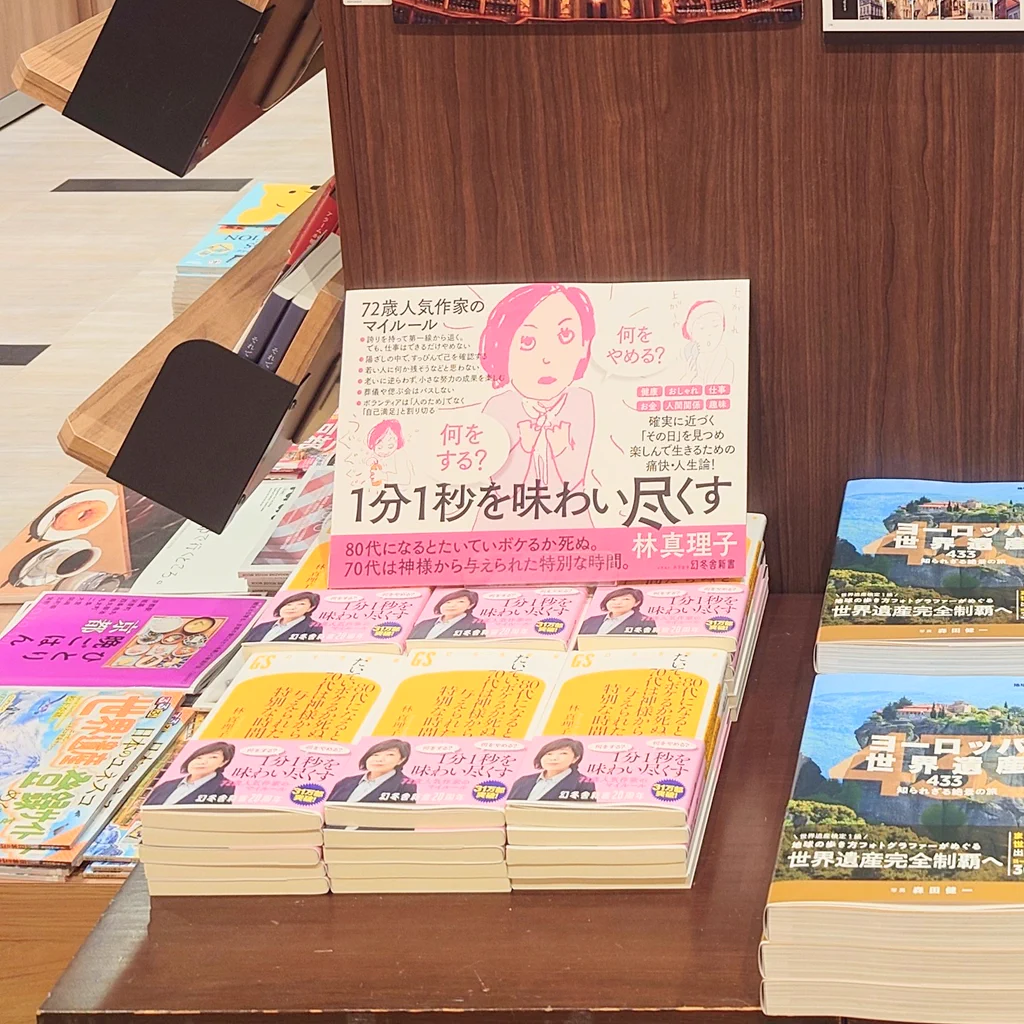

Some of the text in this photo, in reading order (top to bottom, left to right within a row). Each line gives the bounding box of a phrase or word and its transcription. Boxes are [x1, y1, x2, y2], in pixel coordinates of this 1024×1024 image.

[361, 298, 485, 317] 72歳人気作家の
[364, 319, 438, 333] マイルール
[617, 326, 652, 344] 何を
[641, 386, 726, 396] 健康 おしゃれ 仕事
[641, 402, 658, 411] お金
[666, 401, 699, 410] 人間関係
[649, 415, 714, 427] 確実に近づく
[441, 423, 483, 446] 何を
[641, 431, 725, 442] 「その日」を見つめ
[630, 445, 735, 457] 楽しんで生きるための
[350, 476, 732, 530] 1分1秒を味わい尽くす
[346, 535, 597, 557] 80代になるとたいていボケるか死ぬ。
[632, 531, 737, 559] 林真理子
[946, 550, 976, 559] 433
[343, 553, 629, 577] 70代は神様から与えられた特別な時間。
[691, 559, 734, 569] 幻冬舎新書
[343, 600, 413, 610] 1分1秒を
[503, 597, 572, 607] 1分1秒を
[669, 596, 739, 606] 1分1秒を
[832, 605, 1012, 618] 世界遺産完全制覇へ
[81, 619, 140, 634] 京都
[9, 634, 122, 649] 晩ごはん
[22, 651, 105, 663] ひとり
[250, 655, 276, 670] GS
[411, 652, 436, 666] GS
[571, 654, 594, 668] GS
[59, 695, 154, 767] 世界遺産
[261, 754, 340, 770] 1分1秒を
[439, 753, 516, 766] 1分1秒を
[614, 752, 690, 765] 1分1秒を
[587, 763, 689, 776] 味わい尽くす
[926, 775, 962, 787] 433
[788, 851, 1003, 870] 世界遺産完全制覇へ
